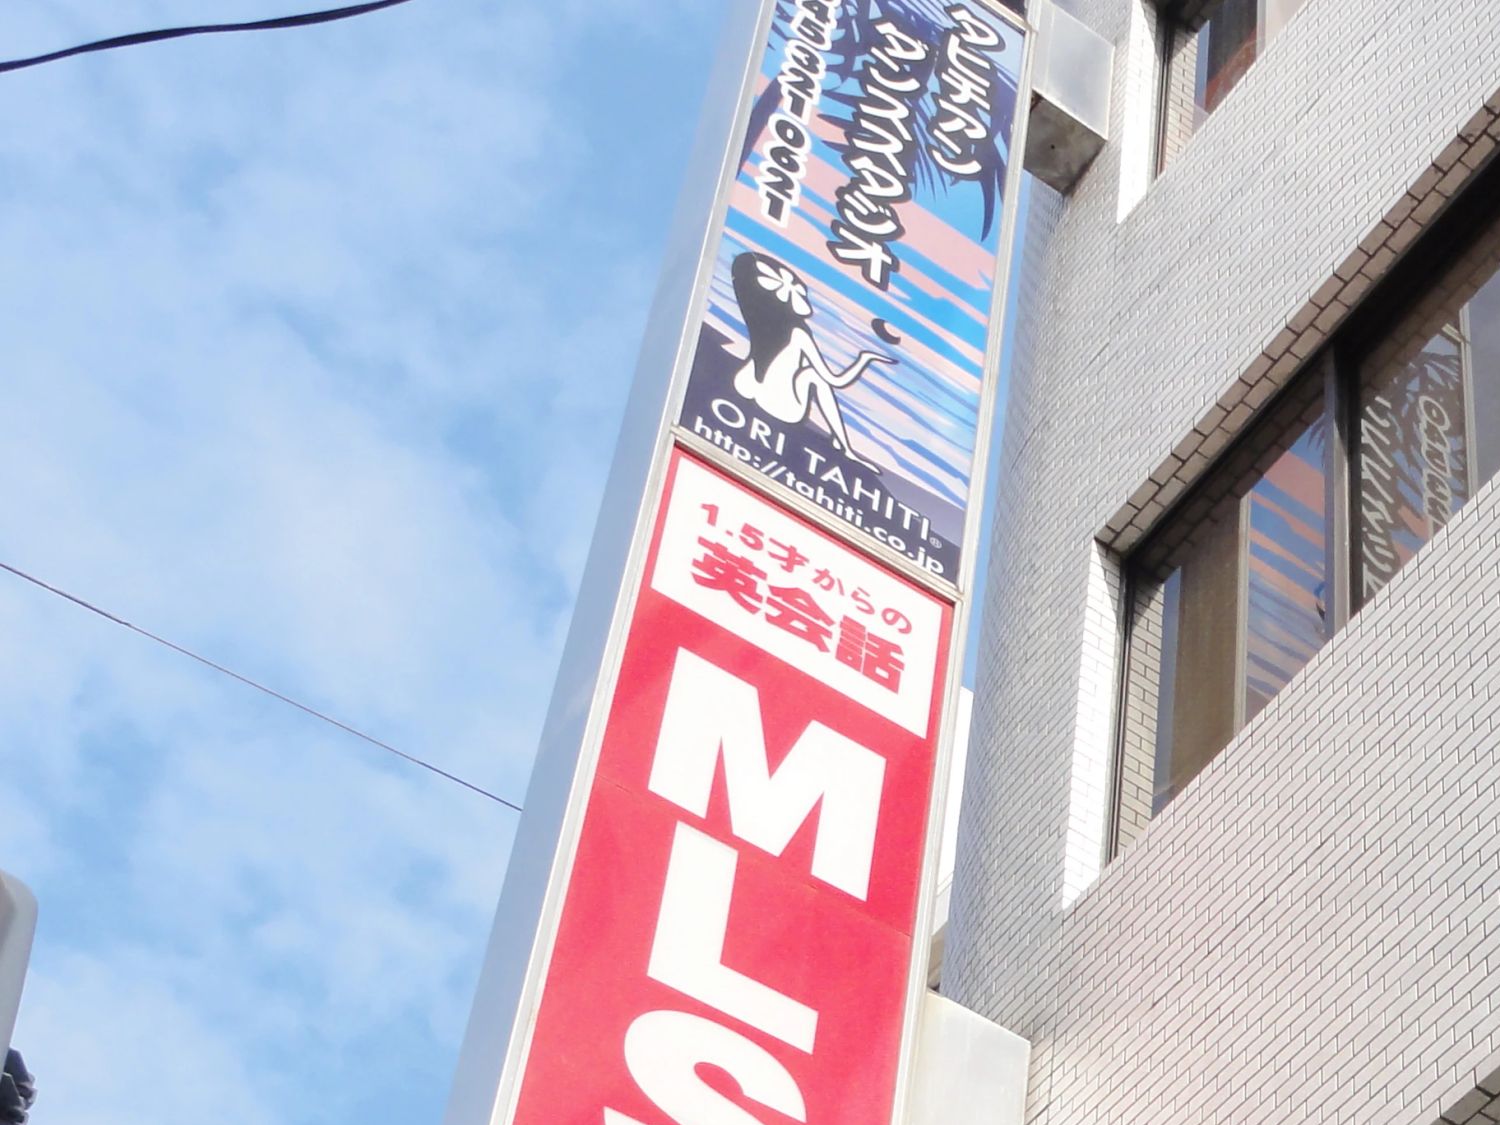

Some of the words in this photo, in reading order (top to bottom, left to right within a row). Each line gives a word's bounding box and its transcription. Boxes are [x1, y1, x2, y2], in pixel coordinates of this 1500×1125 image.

[834, 21, 929, 284] ダンススタジオ
[694, 416, 944, 574] http://tahiti.co.jp
[711, 398, 786, 456] ORI
[803, 447, 930, 541] TAHITI
[690, 536, 905, 695] 英会話
